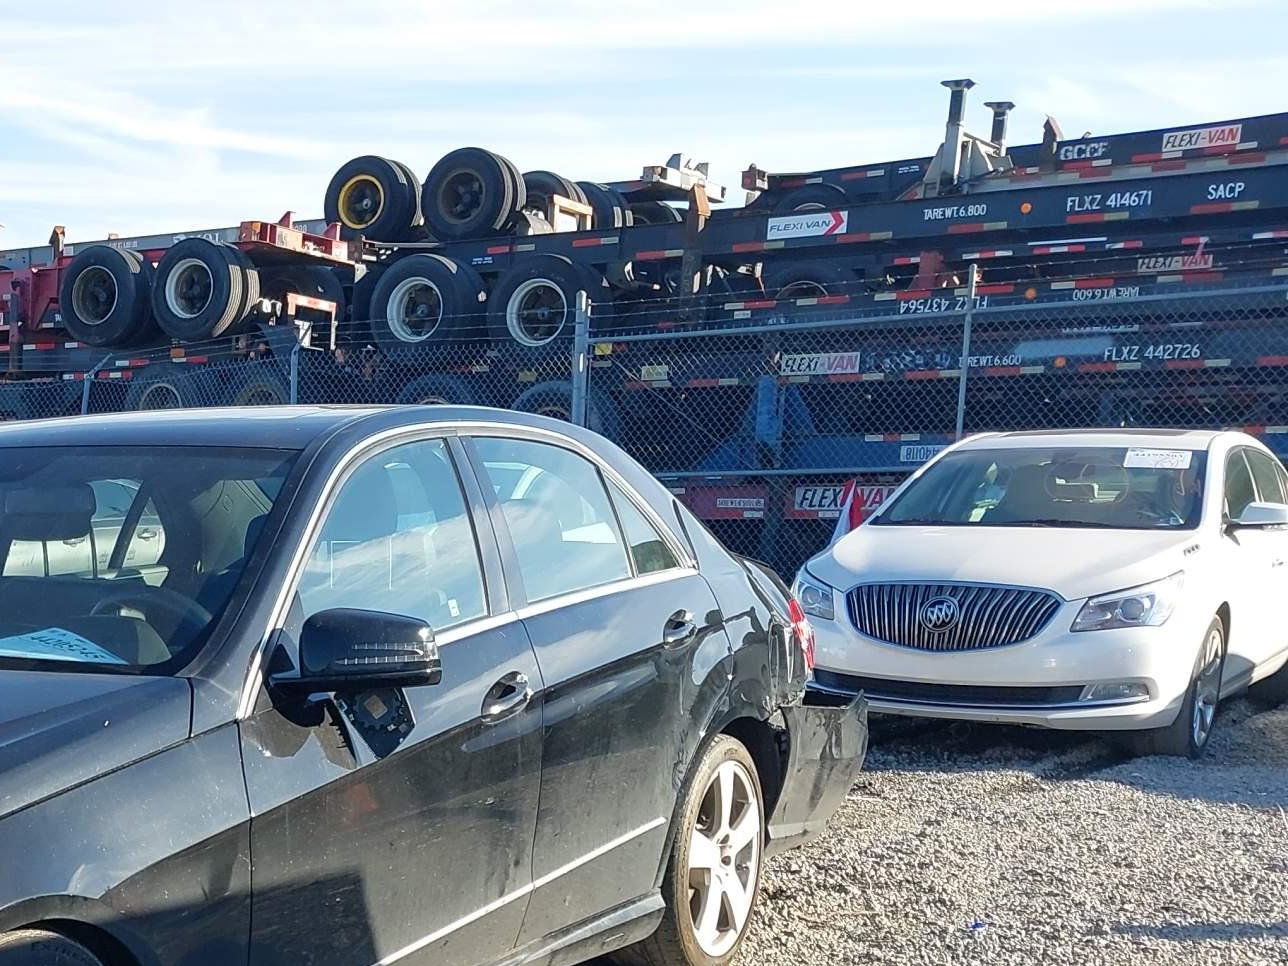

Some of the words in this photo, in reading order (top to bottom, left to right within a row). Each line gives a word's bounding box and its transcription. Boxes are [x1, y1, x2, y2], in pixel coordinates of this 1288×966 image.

[1164, 126, 1240, 149] FLEXI-VAN
[1207, 182, 1245, 200] SACP
[1066, 195, 1101, 212] FLXZ
[1105, 190, 1152, 207] 414671
[769, 222, 804, 232] FLEXI
[805, 219, 831, 229] VAN
[899, 297, 950, 314] 437564
[1103, 345, 1139, 361] FLXZ
[1143, 343, 1201, 360] 442726
